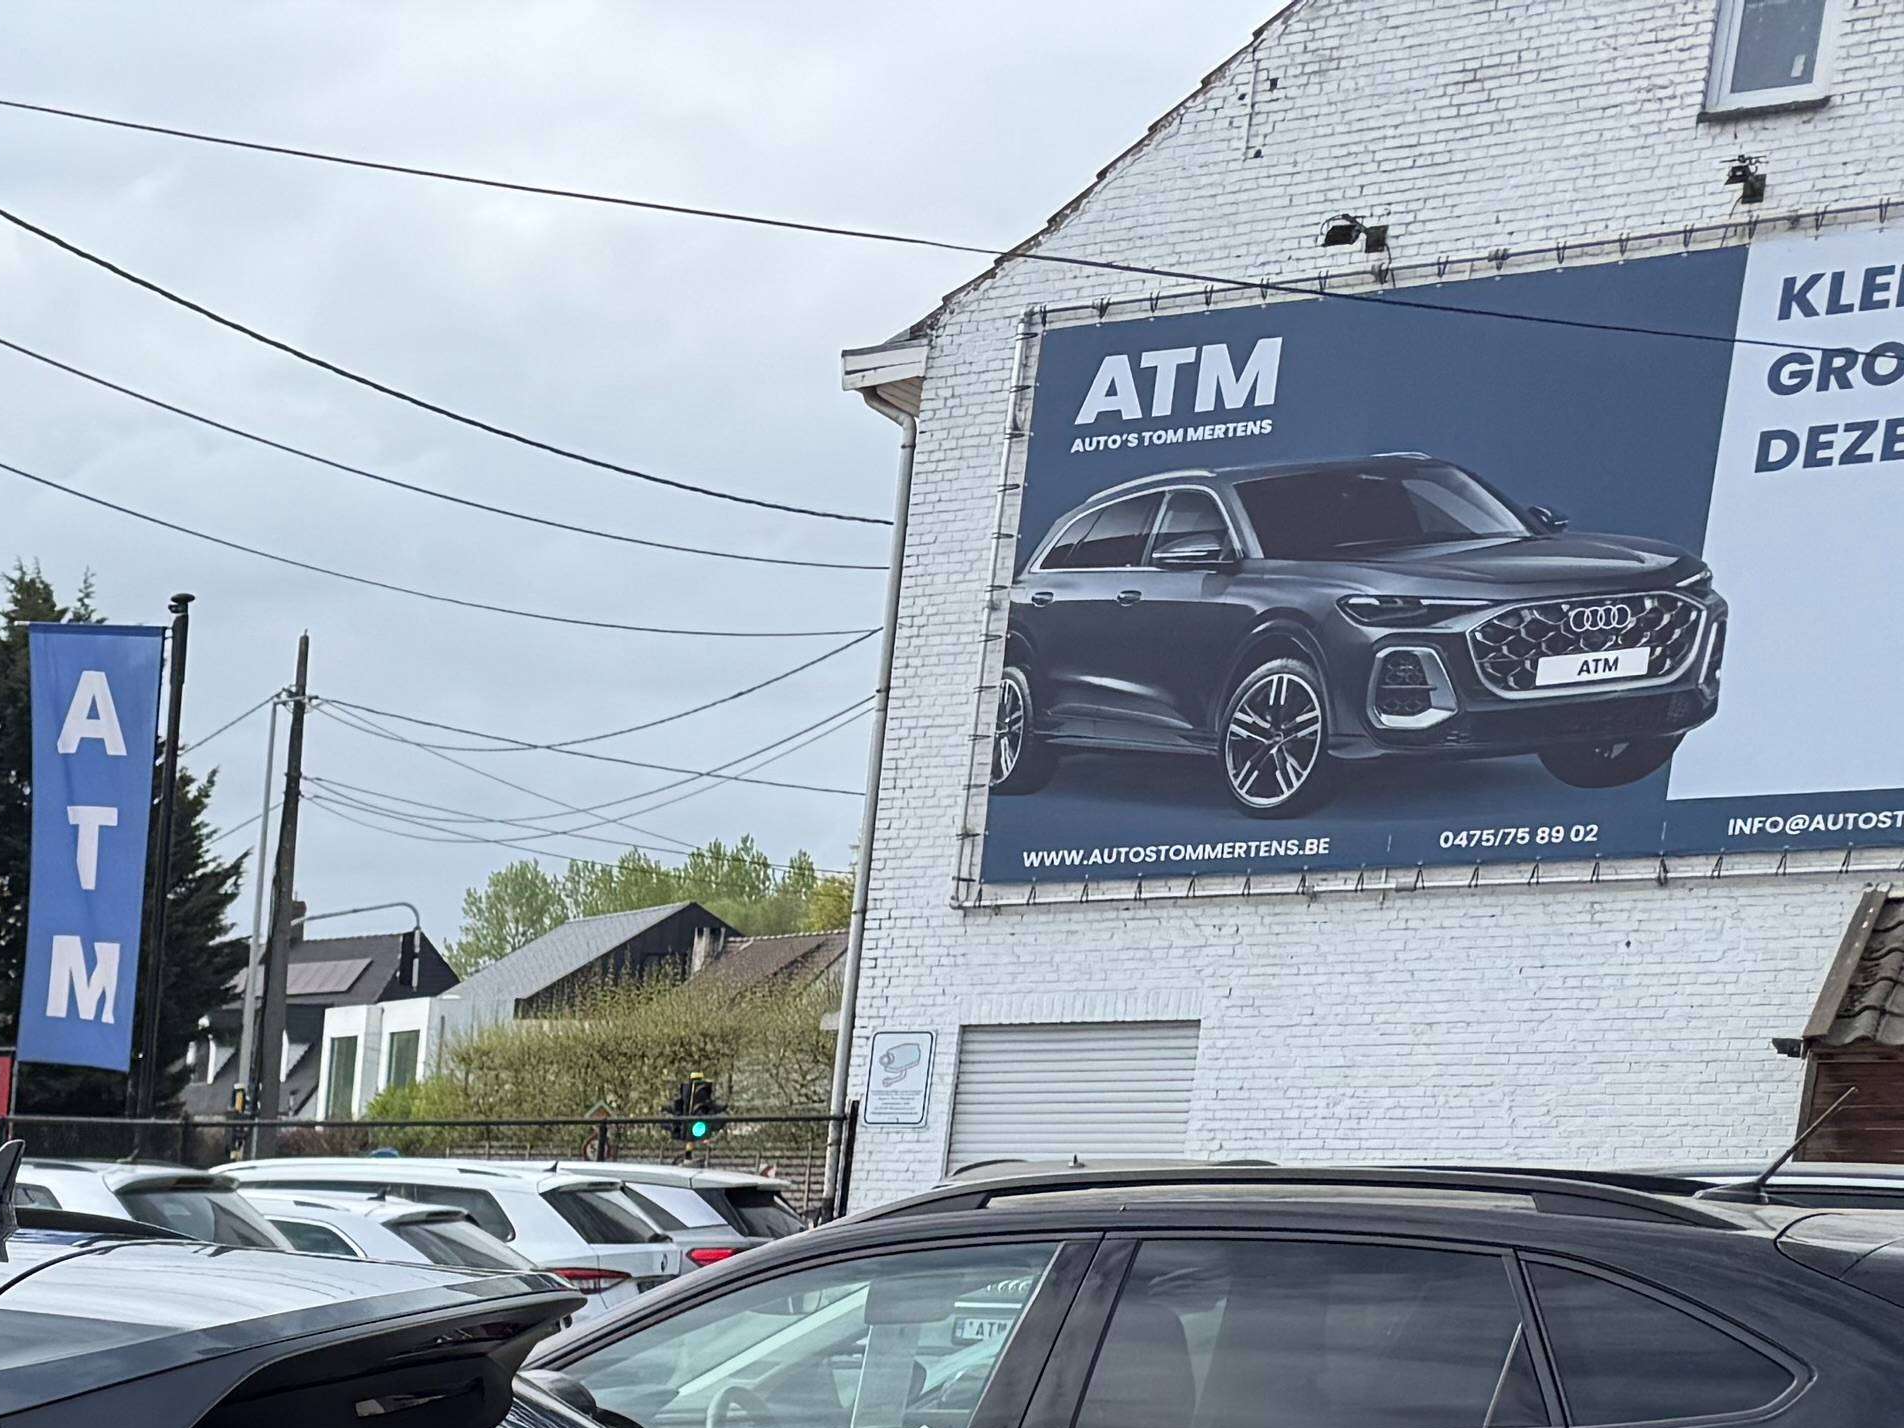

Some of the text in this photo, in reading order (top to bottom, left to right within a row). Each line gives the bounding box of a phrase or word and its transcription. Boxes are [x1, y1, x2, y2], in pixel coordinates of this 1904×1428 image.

[1778, 264, 1904, 321] KLE
[1075, 337, 1283, 425] ATM
[1071, 419, 1272, 453] AUTO'S TOM MERTENS
[1576, 654, 1620, 678] ATM
[1023, 837, 1330, 867] WWW.AUTOSTOMMERTENS.BE
[1439, 825, 1599, 848] 0475/75 89 02
